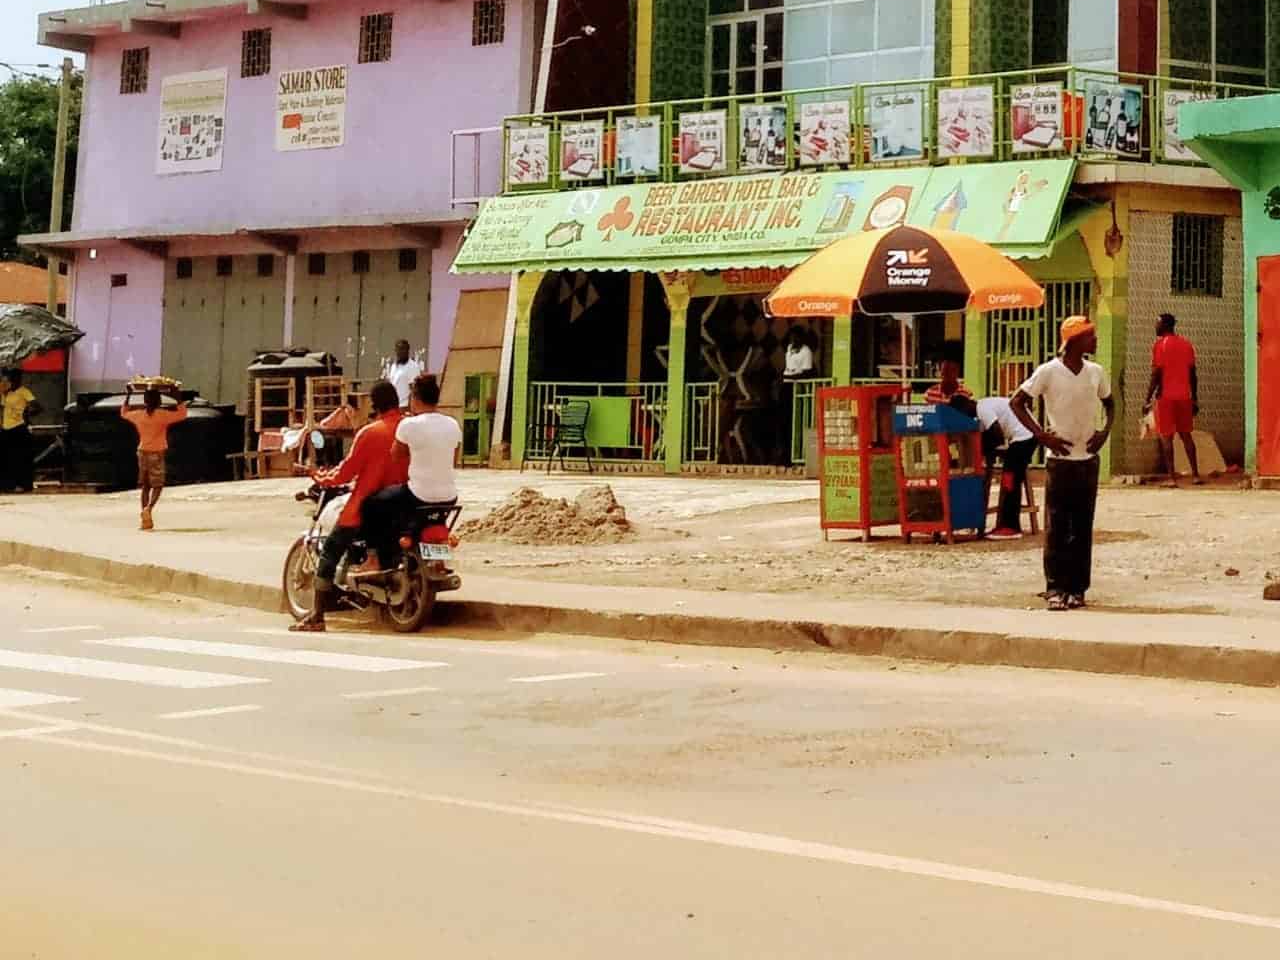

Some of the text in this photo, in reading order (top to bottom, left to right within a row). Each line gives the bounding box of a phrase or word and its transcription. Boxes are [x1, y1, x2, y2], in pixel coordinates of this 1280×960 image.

[314, 66, 346, 91] STORE
[644, 185, 677, 207] BEER
[678, 182, 731, 204] GARDEN
[733, 179, 774, 201] HOTEL
[777, 177, 808, 199] BAR
[632, 201, 767, 237] RESTAURANT
[887, 267, 931, 278] Orange
[887, 277, 929, 286] Money
[799, 300, 838, 312] Orange
[988, 294, 1021, 306] Orange
